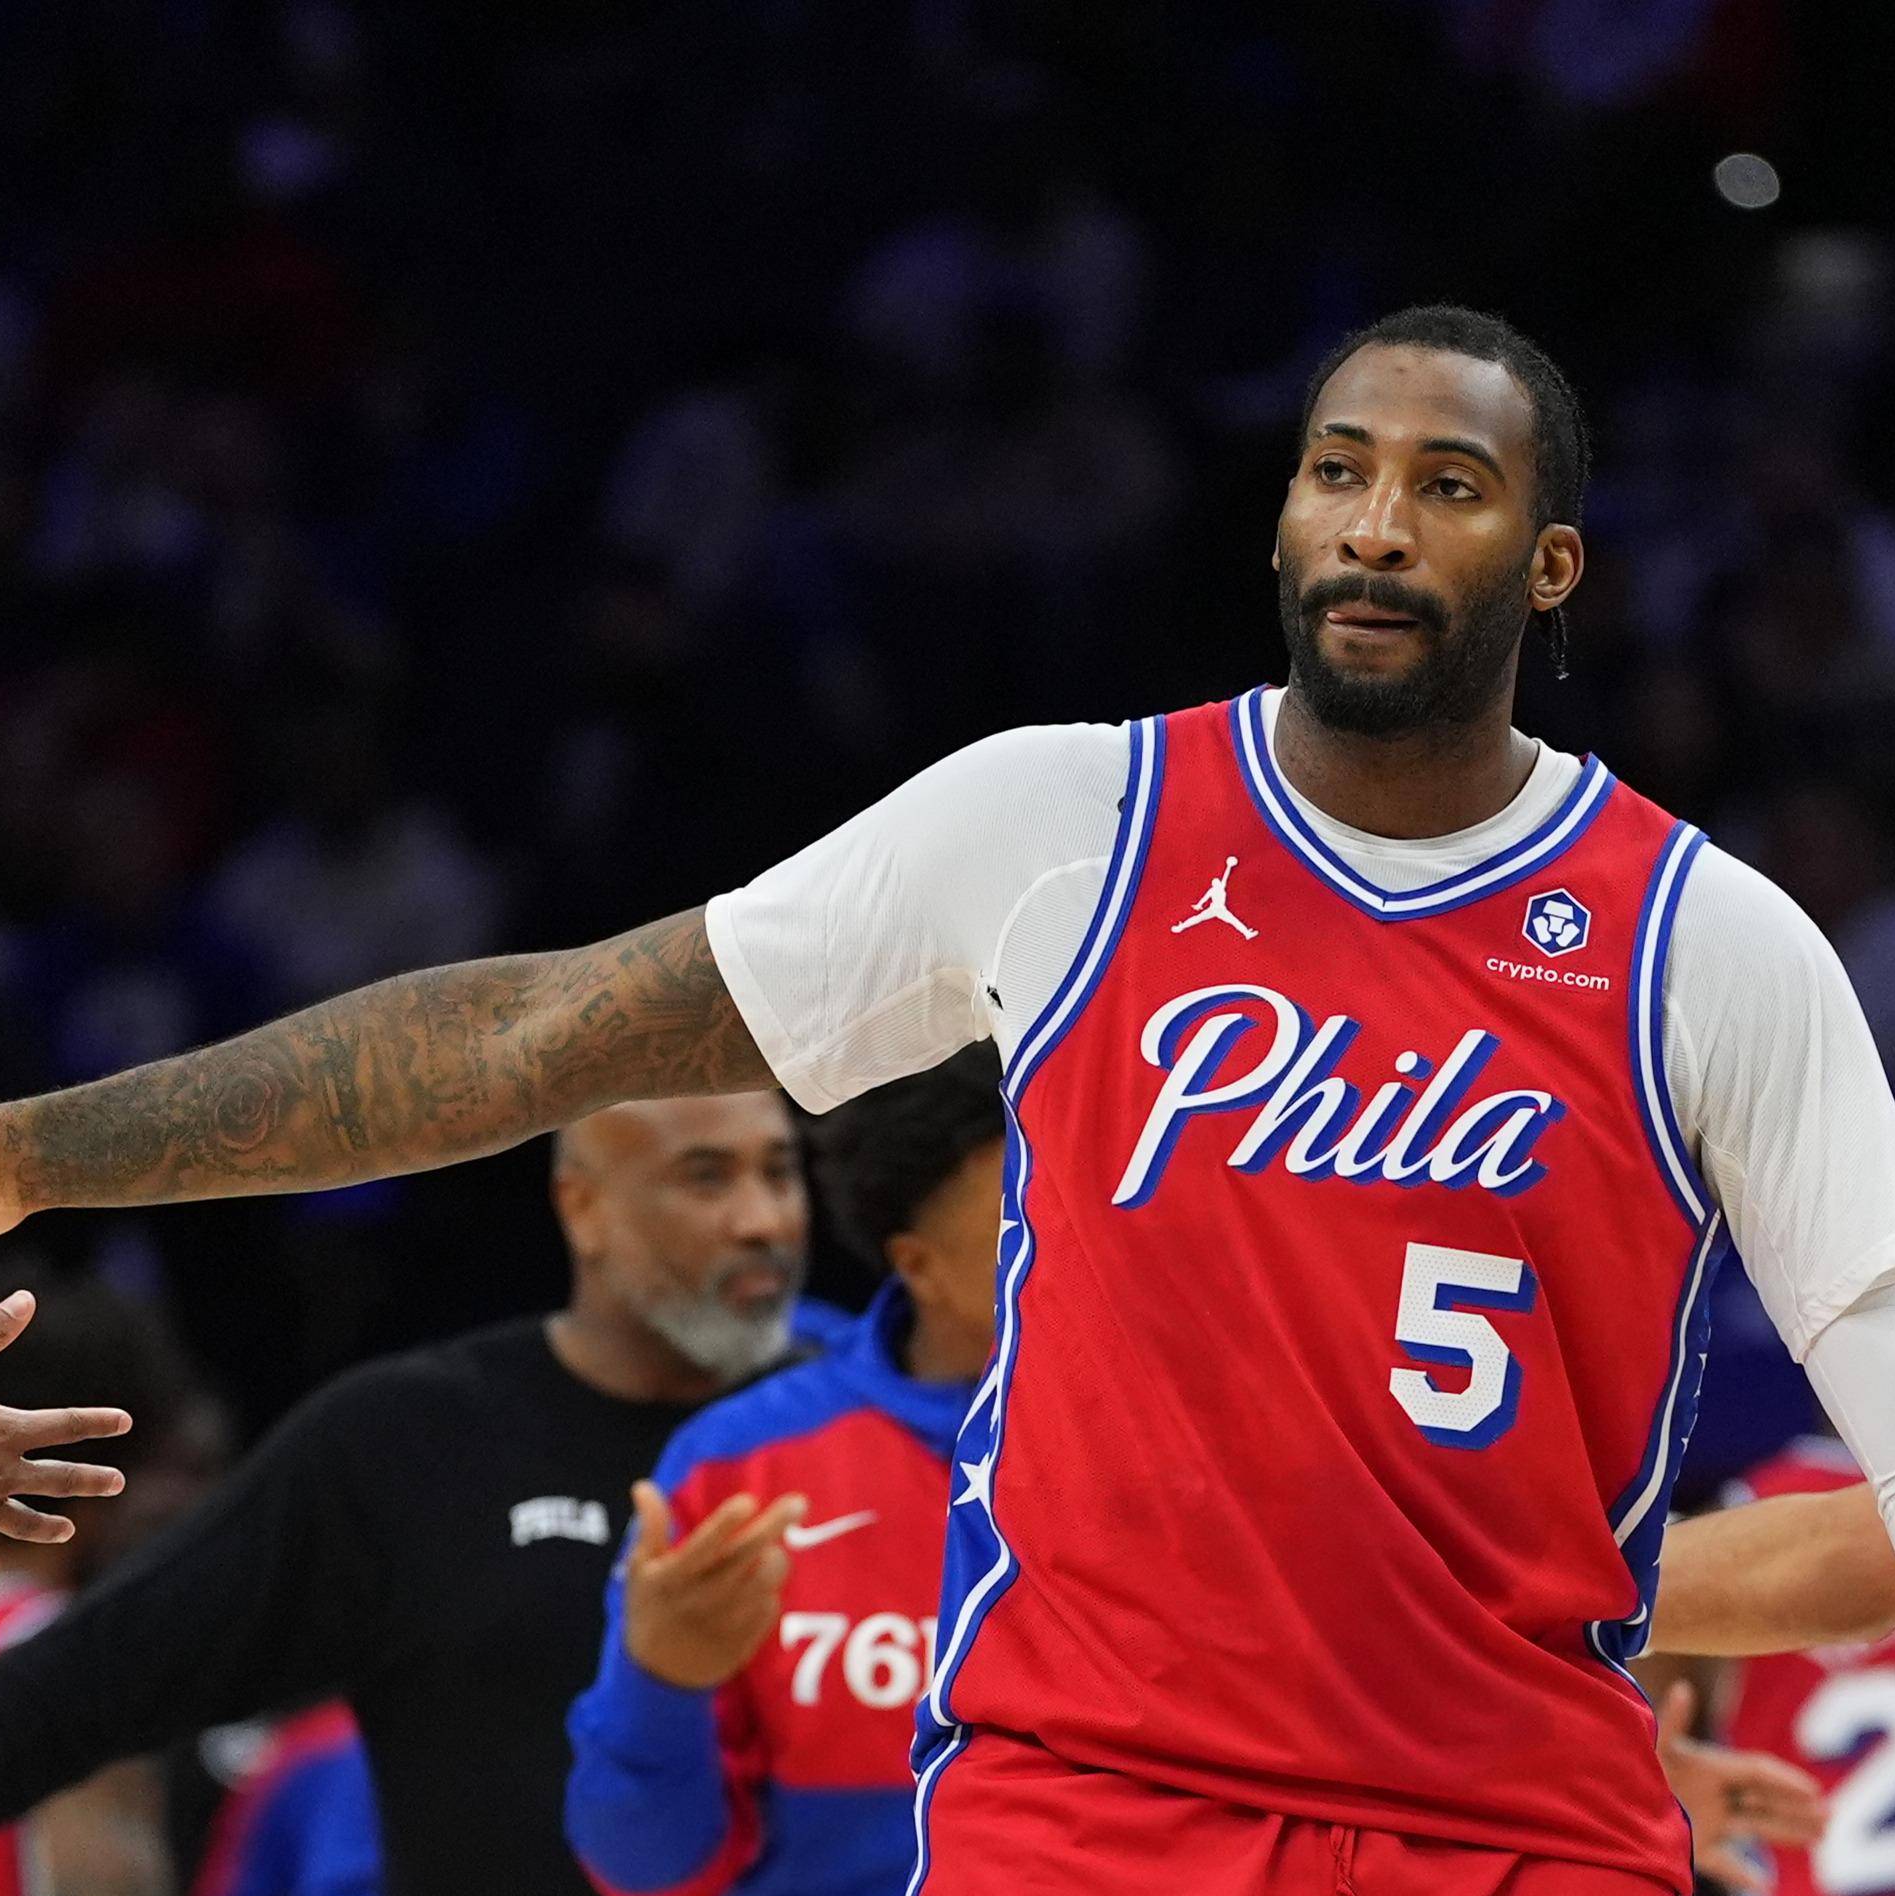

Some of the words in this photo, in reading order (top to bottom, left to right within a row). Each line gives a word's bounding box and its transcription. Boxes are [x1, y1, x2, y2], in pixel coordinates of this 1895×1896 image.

[1486, 958, 1610, 990] crypto.com
[1110, 984, 1559, 1208] Phila
[1388, 1241, 1528, 1436] 5
